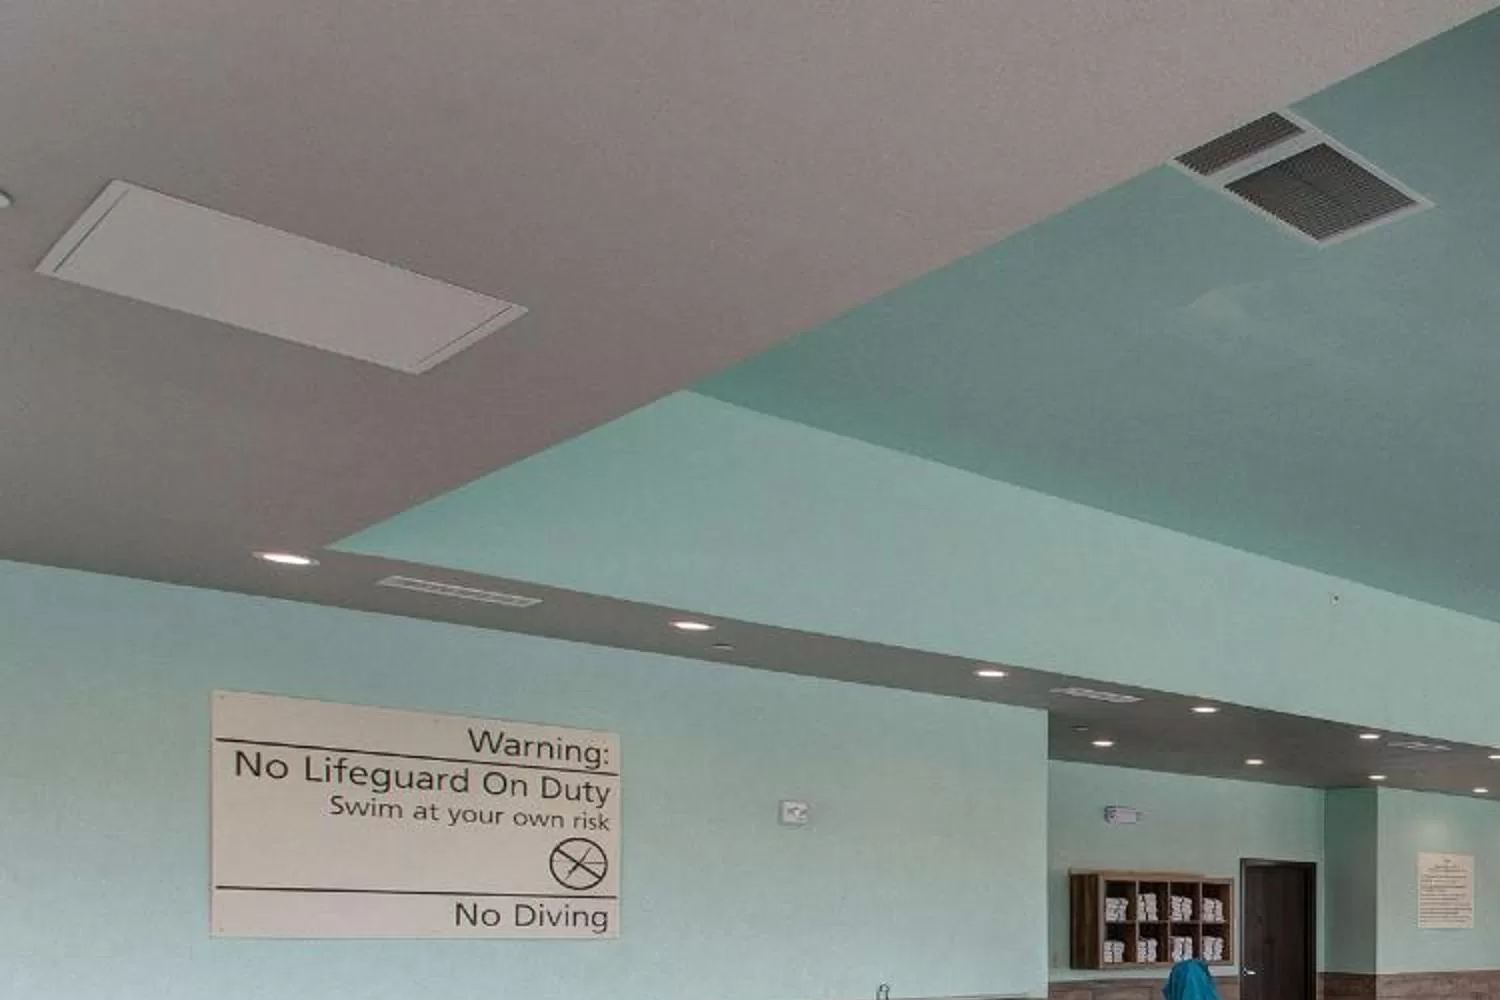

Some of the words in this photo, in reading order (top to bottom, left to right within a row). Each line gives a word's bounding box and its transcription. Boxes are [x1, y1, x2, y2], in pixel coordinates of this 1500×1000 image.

[467, 727, 610, 769] Warning:
[234, 750, 290, 781] No
[304, 755, 469, 795] Lifeguard
[483, 771, 529, 797] On
[541, 775, 611, 807] Duty
[329, 795, 404, 820] Swim
[413, 803, 440, 821] at
[447, 807, 503, 827] your
[513, 812, 565, 829] own
[573, 811, 610, 831] risk
[455, 903, 501, 928] No
[514, 903, 609, 934] Diving
